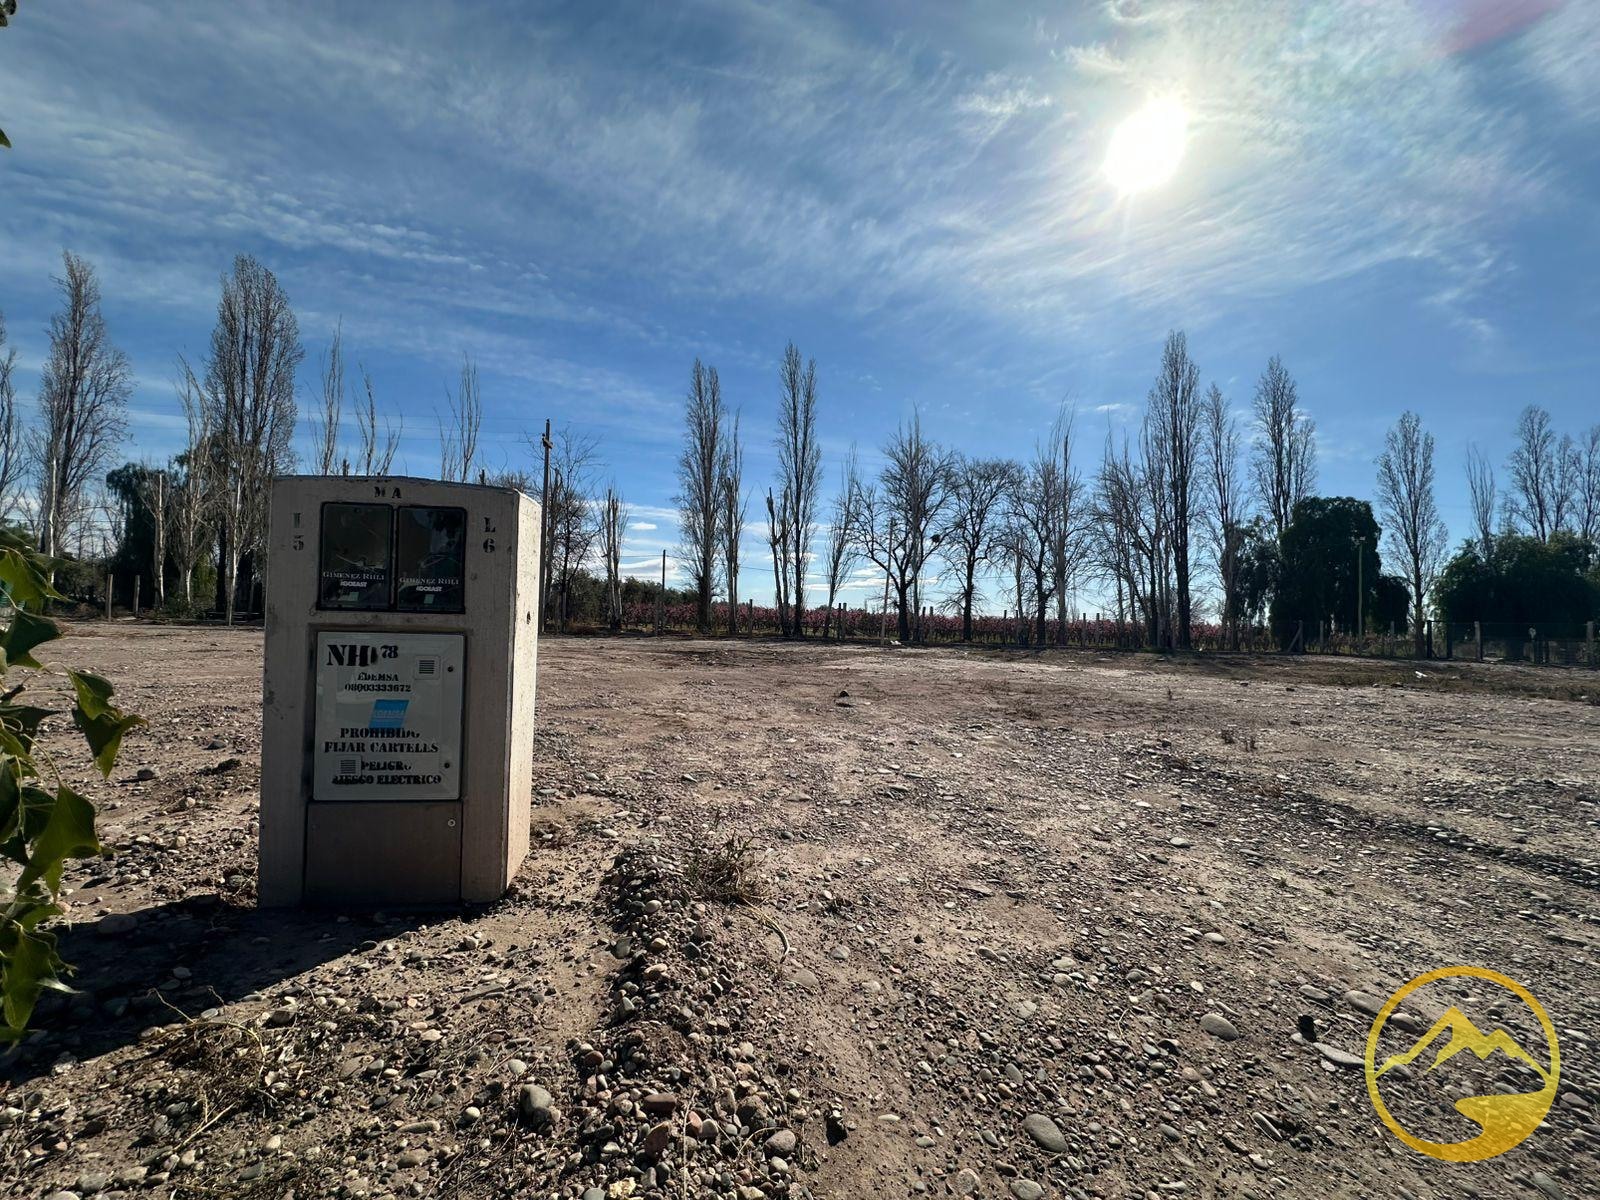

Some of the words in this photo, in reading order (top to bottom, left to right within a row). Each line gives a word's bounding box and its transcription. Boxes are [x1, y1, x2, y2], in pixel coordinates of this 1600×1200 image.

[483, 517, 496, 532] L
[293, 534, 304, 551] 5
[483, 538, 495, 553] 6
[380, 645, 399, 659] 78
[357, 672, 399, 682] EDEMSA
[324, 741, 366, 753] FIJAR
[376, 774, 442, 785] ELECTRICO
